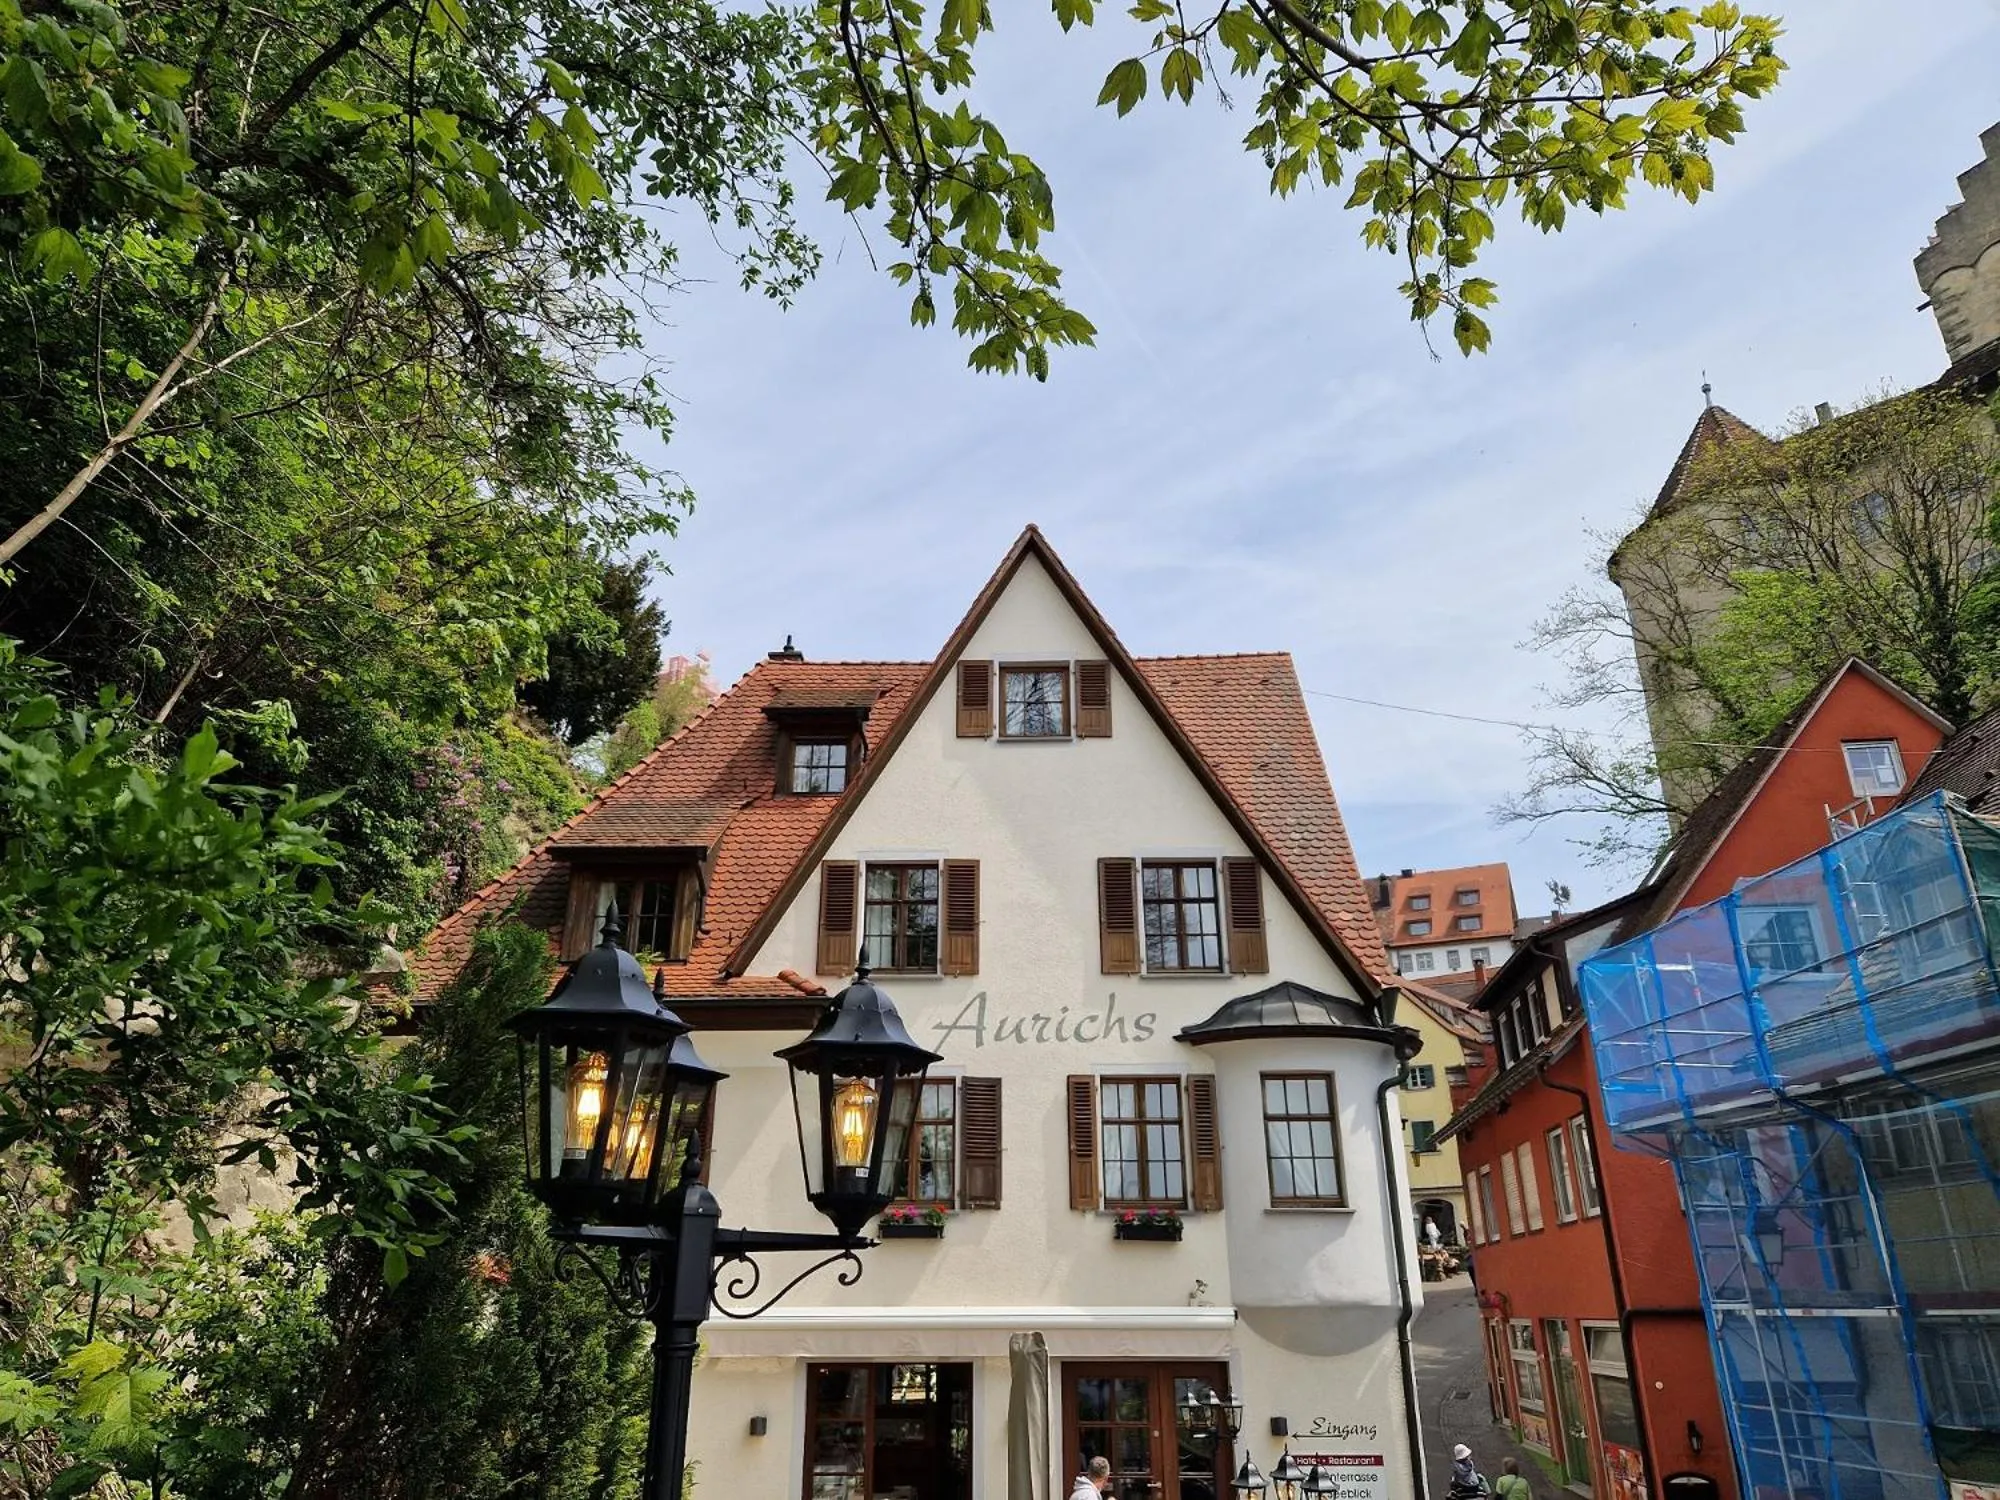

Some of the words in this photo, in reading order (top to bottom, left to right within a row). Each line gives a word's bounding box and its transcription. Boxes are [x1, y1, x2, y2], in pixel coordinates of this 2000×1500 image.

[931, 991, 1157, 1053] Aurichs
[1309, 1416, 1377, 1440] Eingang
[1296, 1457, 1319, 1465] Hote
[1328, 1456, 1375, 1465] Restaurant
